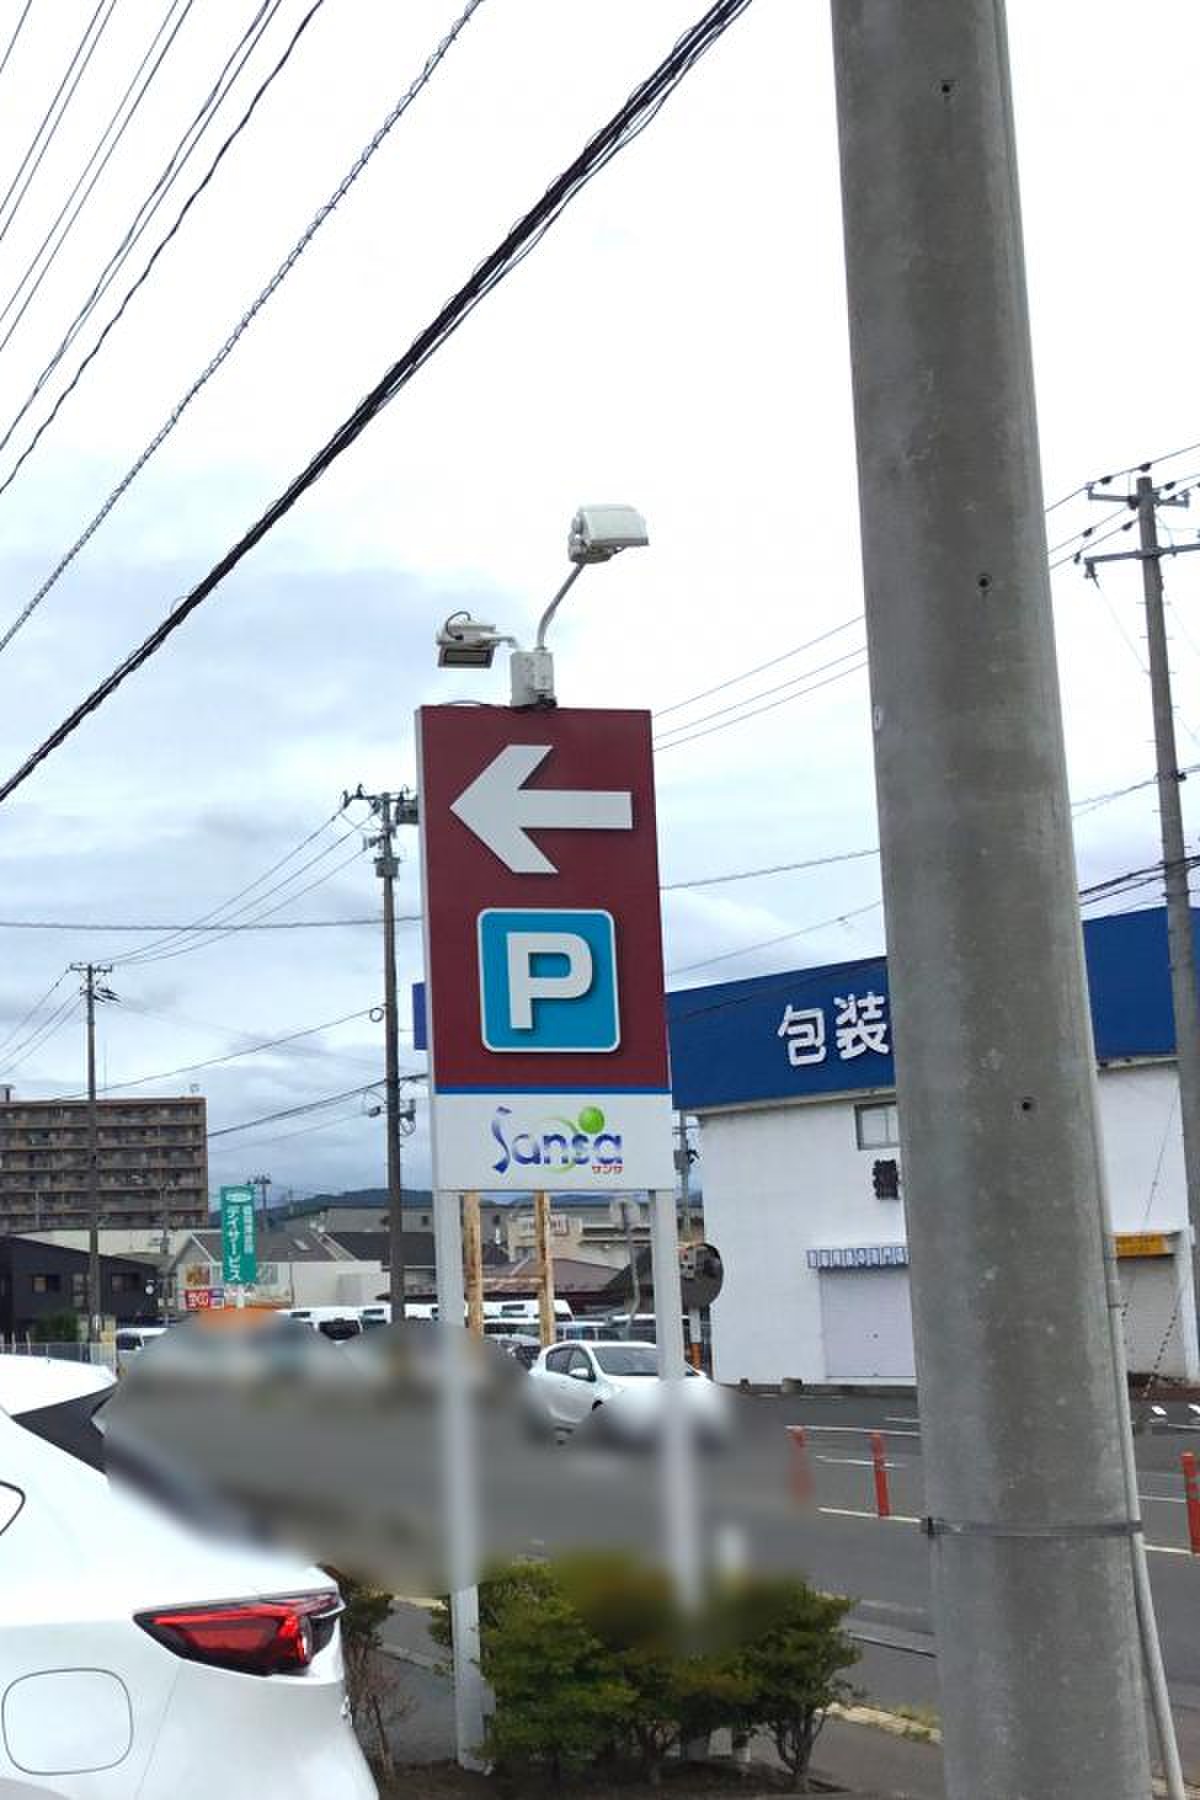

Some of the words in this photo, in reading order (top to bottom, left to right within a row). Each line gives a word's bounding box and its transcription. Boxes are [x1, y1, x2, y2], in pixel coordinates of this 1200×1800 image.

[505, 931, 594, 1030] P
[777, 991, 890, 1066] 包装
[492, 1105, 623, 1174] Sansa
